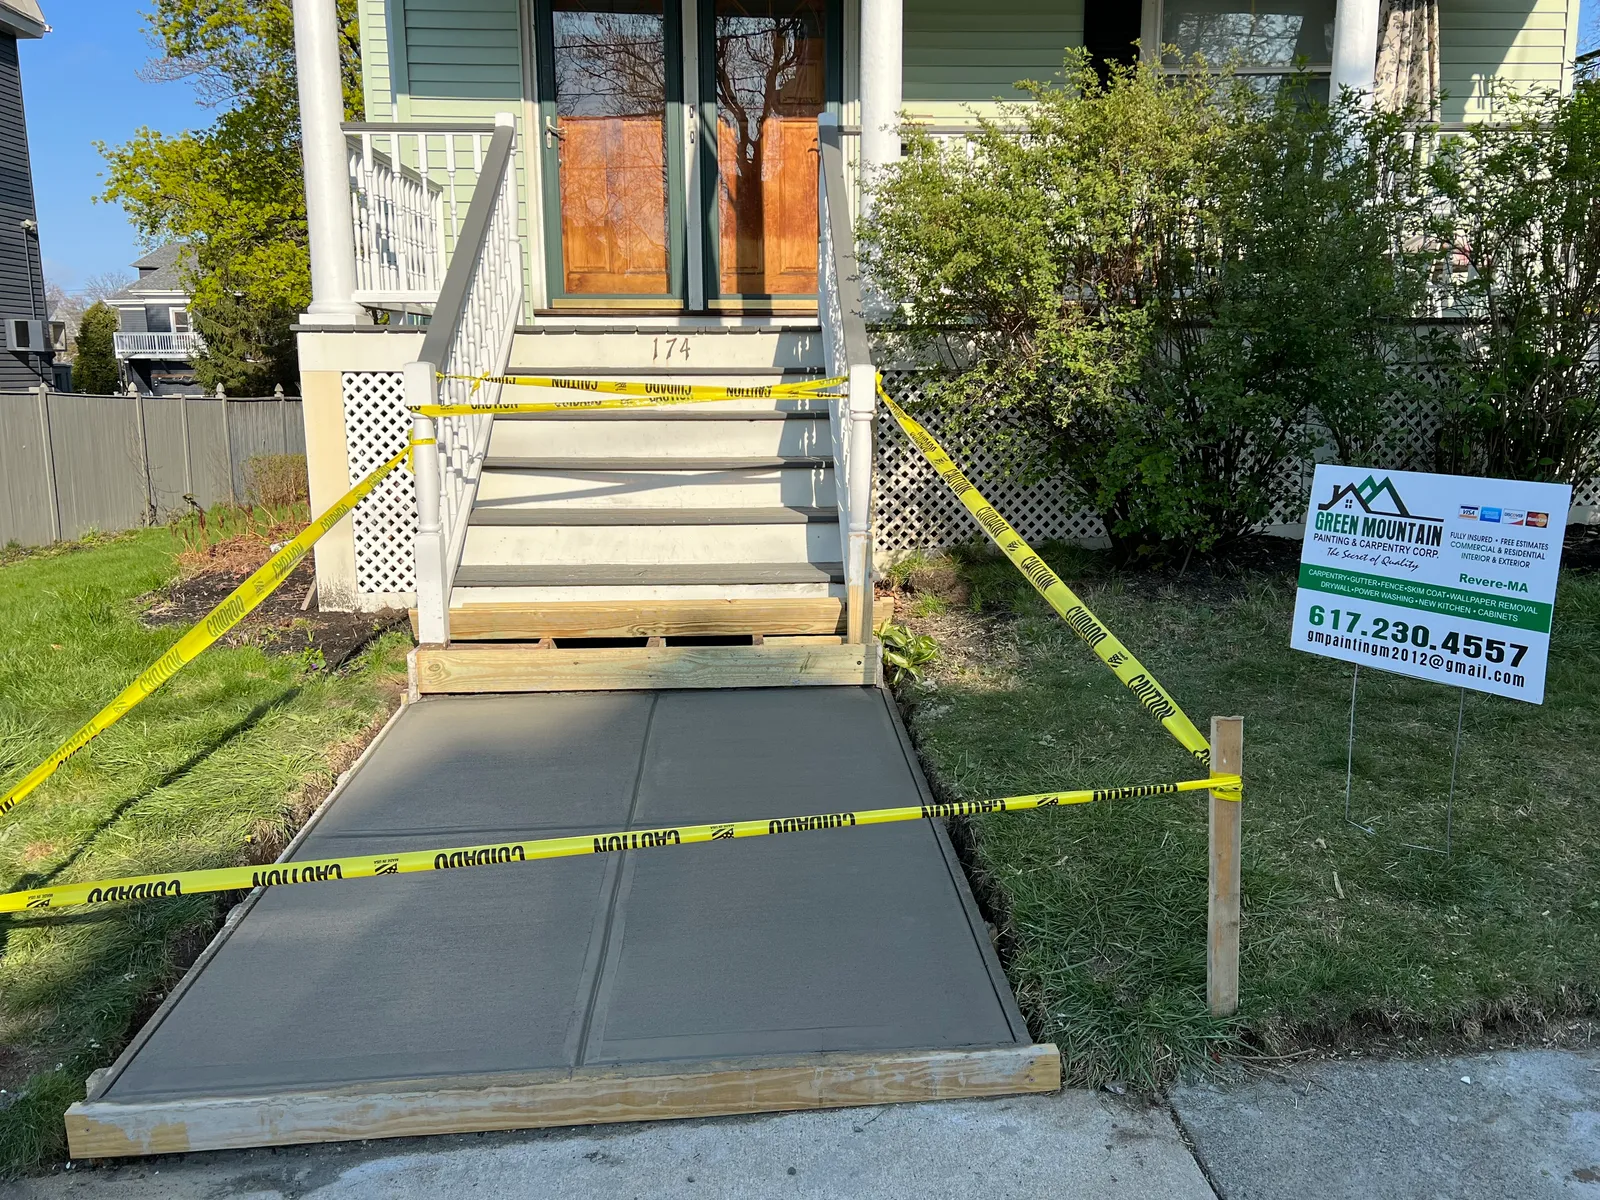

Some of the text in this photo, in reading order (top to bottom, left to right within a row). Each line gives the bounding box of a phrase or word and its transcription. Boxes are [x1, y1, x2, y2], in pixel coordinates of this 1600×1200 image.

[653, 337, 690, 361] 174
[1315, 511, 1443, 547] GREEN MOUNTAIN
[1450, 531, 1549, 551] FULLY INSURED FREE ESTIMATES
[1313, 533, 1439, 559] PAINTING & CARPENTRY CORP.
[1450, 541, 1496, 554] COMMERCIAL
[1504, 548, 1545, 560] RESIDENTIAL
[1327, 547, 1420, 572] The Secret of Quality
[1461, 552, 1531, 569] INTERIOR & EXTERIOR
[942, 468, 1176, 722] CAUTION CUIDADO CAUTION CUIDADO CAUTION
[1459, 573, 1529, 593] Revere-MA
[1381, 592, 1414, 604] WASHING
[1418, 599, 1437, 608] NEW
[1437, 603, 1471, 614] KITCHEN
[1477, 609, 1519, 622] CABINETS
[1498, 601, 1538, 615] REMOVAL
[1309, 605, 1529, 668] 617.230.4557
[1307, 630, 1525, 688] gmpaintingm2012@gmail.com
[921, 799, 1006, 819] CAUTION
[769, 812, 856, 835] CUIDADO
[593, 829, 681, 853] CAUTION
[434, 845, 526, 870] CUIDADO
[252, 863, 344, 887] CAUTION
[87, 879, 183, 903] CUIDADO
